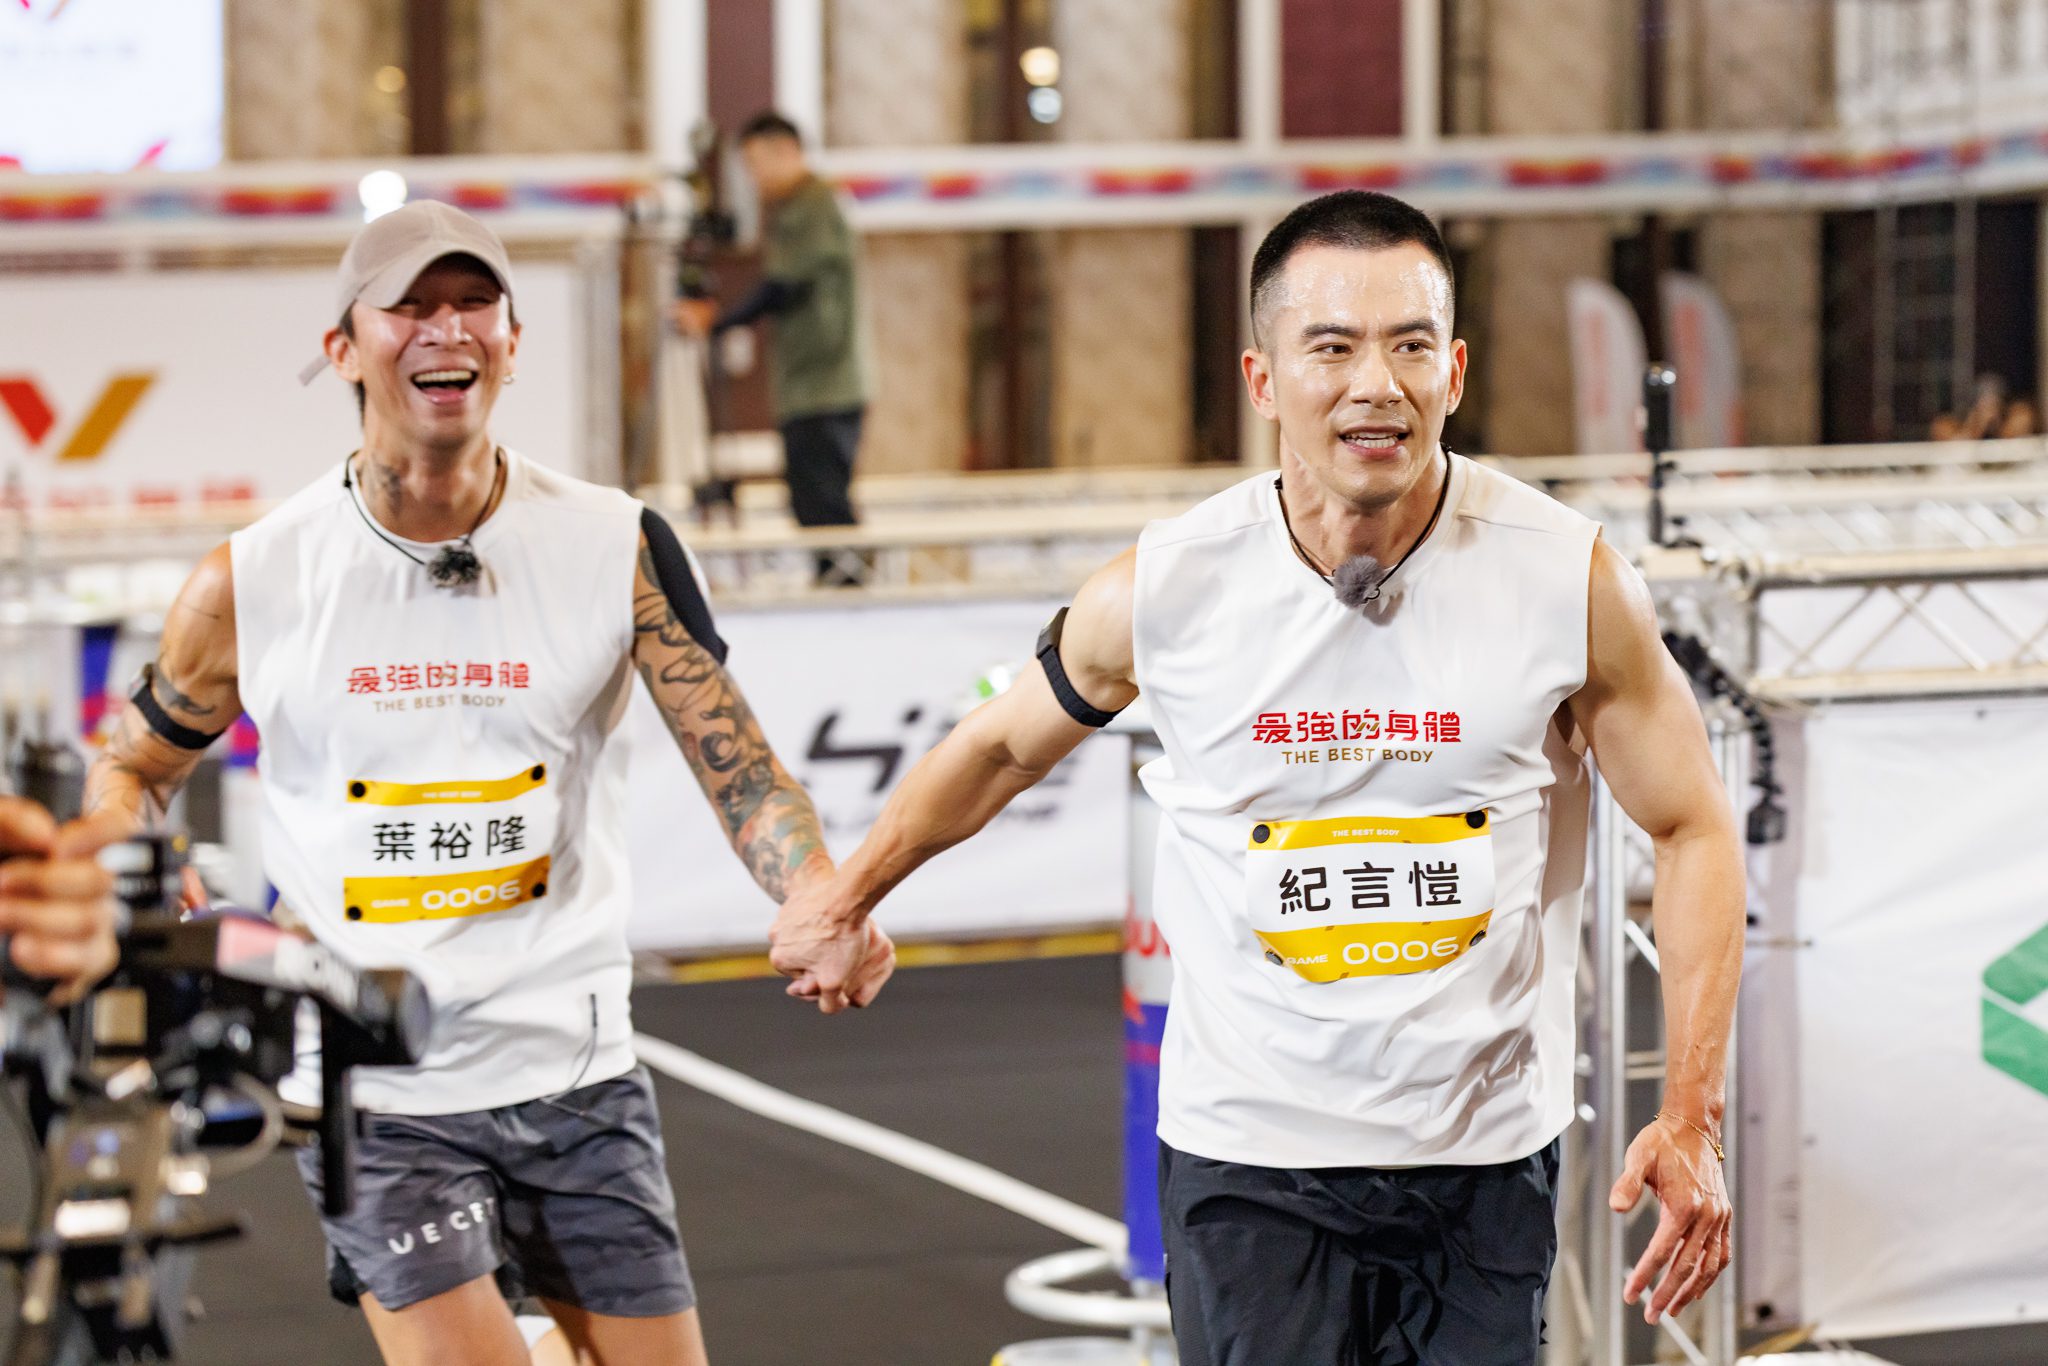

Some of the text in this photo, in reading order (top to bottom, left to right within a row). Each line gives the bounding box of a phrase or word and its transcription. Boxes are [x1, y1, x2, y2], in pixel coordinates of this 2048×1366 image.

[347, 660, 530, 694] 最強的身體
[373, 694, 506, 713] THE BEST BODY
[1251, 708, 1462, 744] 最強的身體
[1281, 747, 1434, 765] THE BEST BODY
[373, 815, 526, 862] 葉裕隆
[1331, 828, 1400, 838] THE BEST BODY
[421, 879, 521, 910] 0006
[1278, 860, 1462, 915] 紀言愷
[1342, 935, 1460, 965] 0006
